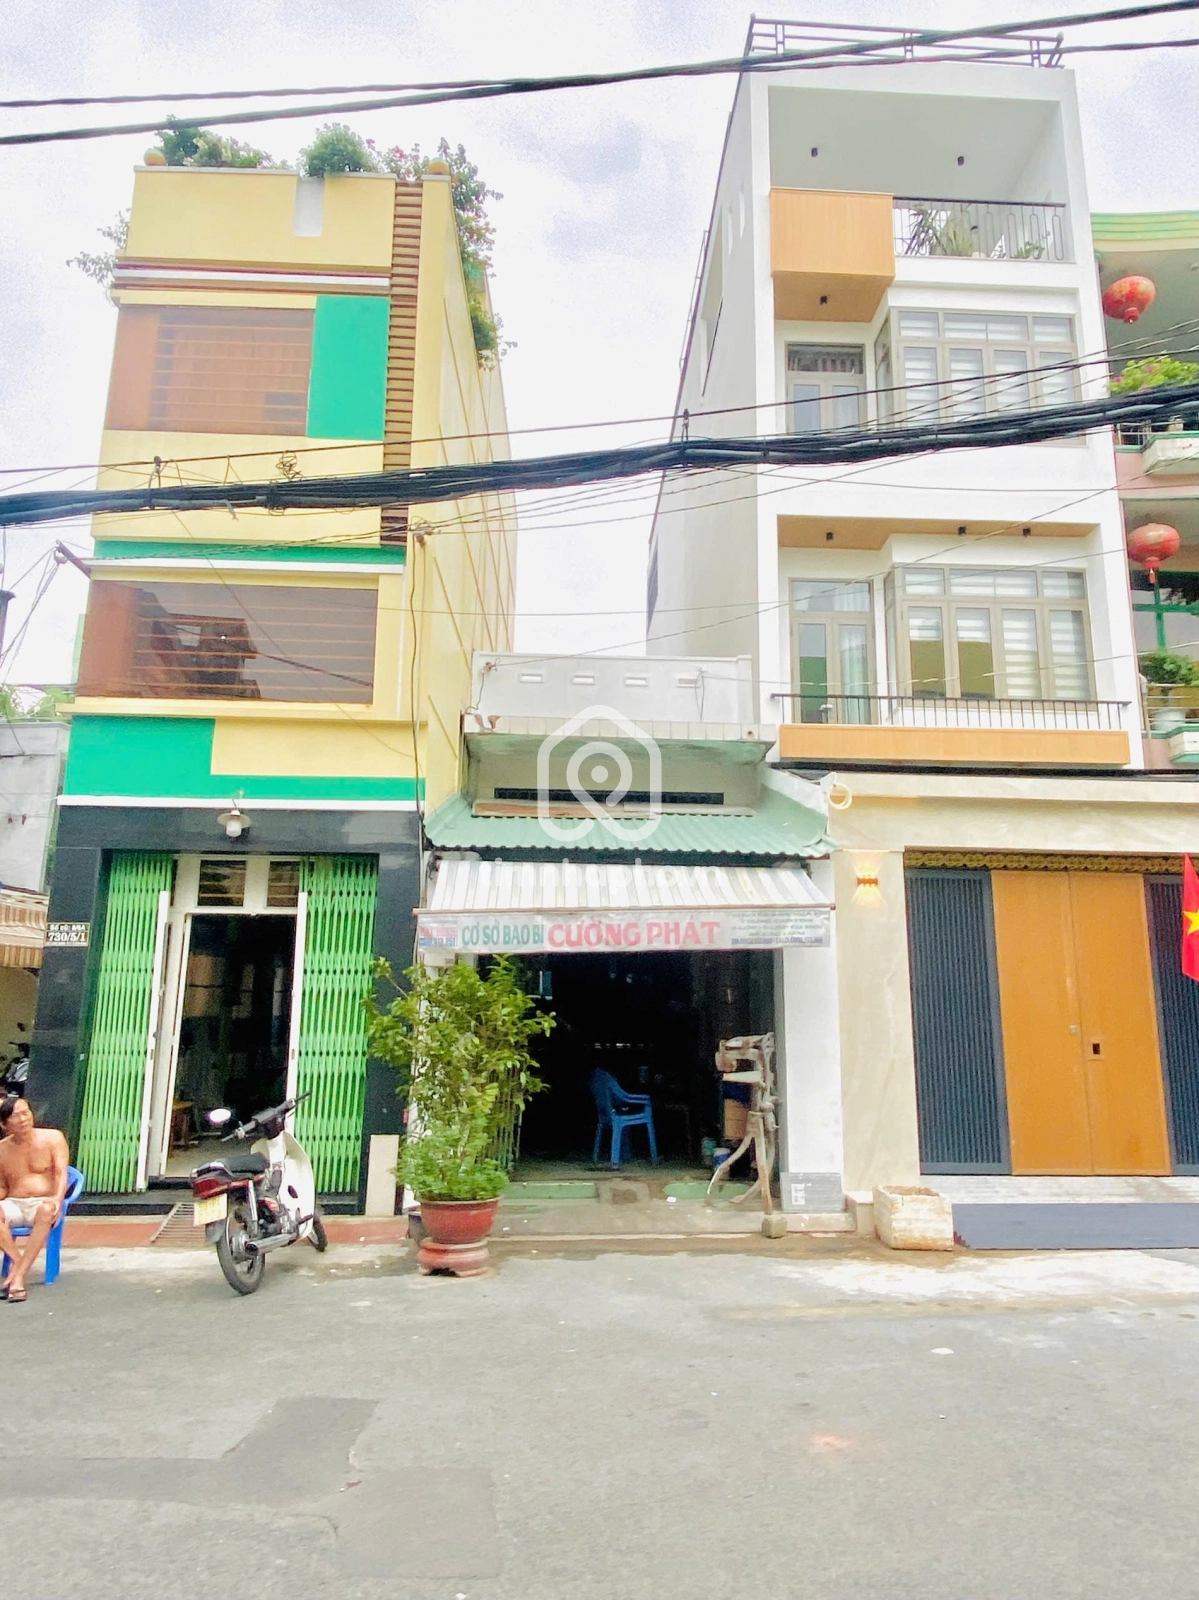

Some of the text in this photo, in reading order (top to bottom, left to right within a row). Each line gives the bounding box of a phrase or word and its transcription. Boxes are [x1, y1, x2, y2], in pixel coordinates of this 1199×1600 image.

[48, 932, 86, 942] 730/5/1
[503, 924, 530, 945] BAO
[547, 916, 641, 948] CƯỜNG
[646, 915, 721, 945] PHÁT
